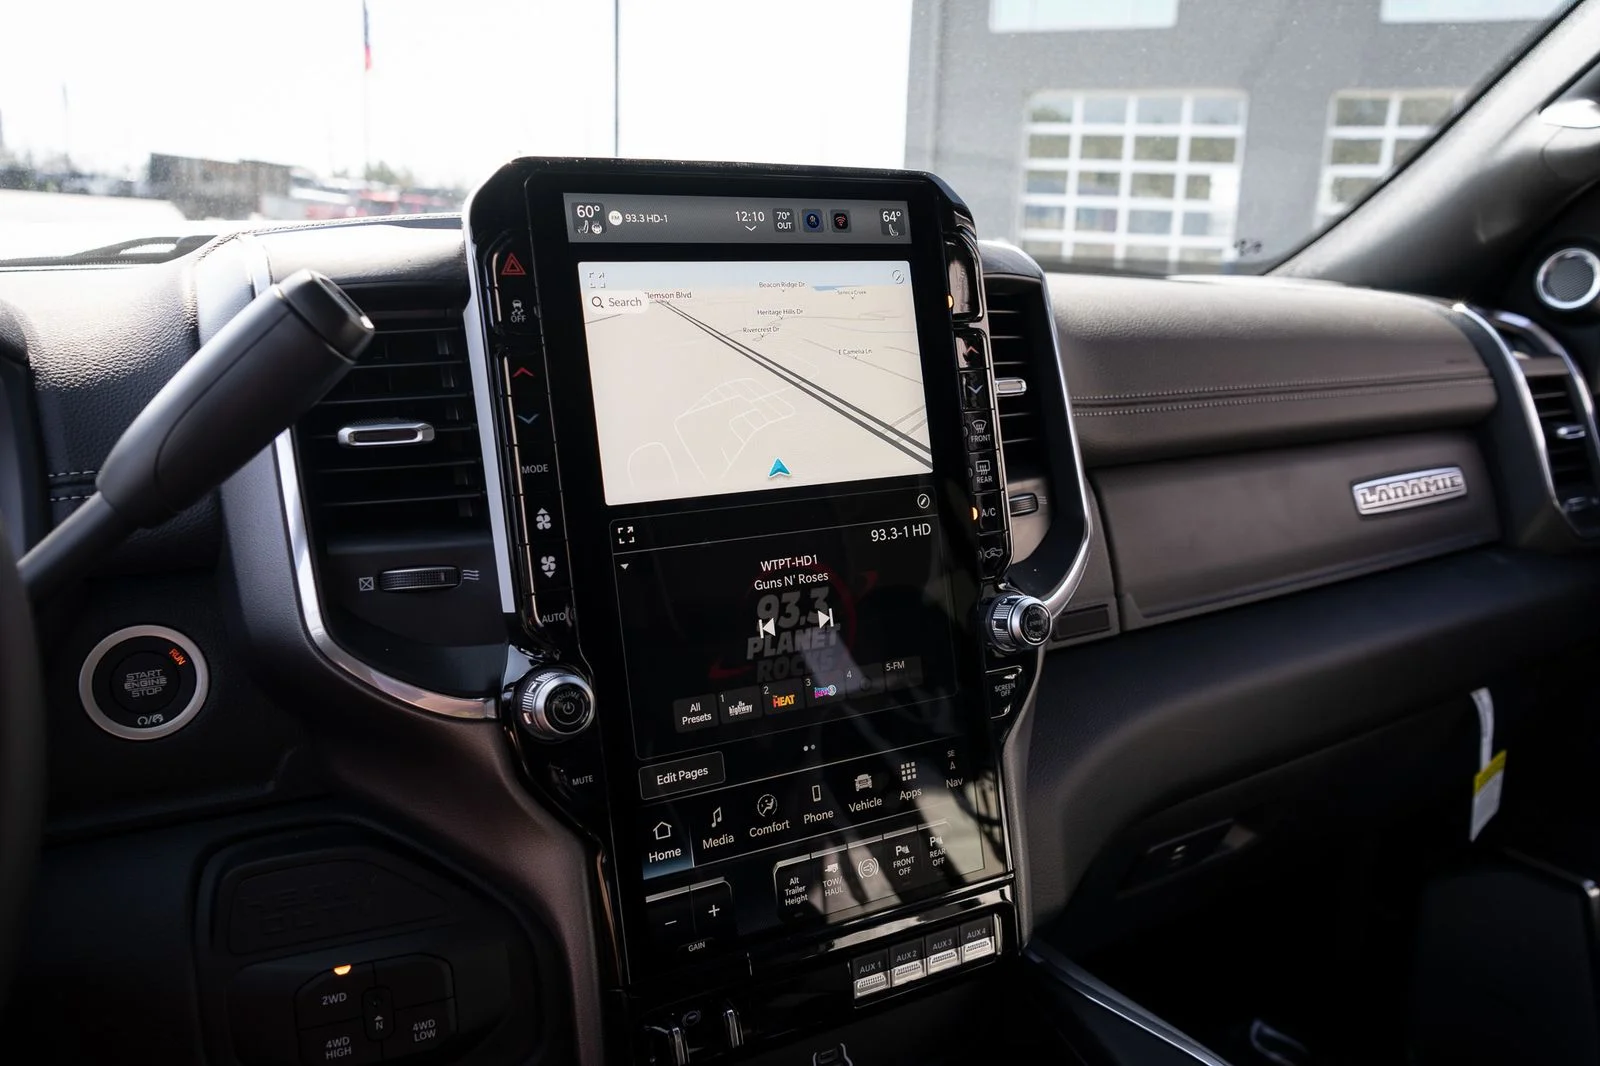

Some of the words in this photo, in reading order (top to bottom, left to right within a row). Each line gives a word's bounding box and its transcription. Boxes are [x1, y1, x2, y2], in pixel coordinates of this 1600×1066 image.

[625, 213, 645, 223] 93.3
[646, 214, 668, 223] HD-1
[735, 211, 765, 222] 12:10
[777, 222, 792, 230] OUT
[759, 281, 780, 289] Beacon
[781, 281, 798, 290] Ridge
[644, 291, 675, 300] lemson
[675, 291, 692, 299] Blvd
[608, 297, 642, 307] Search
[510, 314, 528, 324] OFF
[970, 433, 992, 443] FRONT
[521, 463, 549, 475] MODE
[976, 474, 993, 484] REAR
[981, 507, 997, 518] A/C
[870, 525, 910, 543] 93.3-1
[911, 523, 932, 537] HD
[760, 554, 819, 572] WTPT-HD1
[754, 578, 783, 591] Guns
[784, 575, 796, 587] N'
[798, 571, 829, 585] Roses
[756, 586, 830, 629] 93.3
[542, 611, 566, 624] AUTO
[746, 623, 841, 660] PLANET
[169, 648, 186, 666] RUN
[885, 660, 905, 672] 5-FM
[126, 669, 163, 681] START
[846, 670, 852, 679] 4
[124, 676, 168, 690] ENGINE
[806, 678, 812, 687] 3
[994, 682, 1016, 693] SCREEN
[131, 686, 163, 698] STOP
[764, 685, 769, 695] 2
[1000, 689, 1011, 697] OFF
[720, 694, 725, 703] 1
[773, 694, 796, 709] HEAT
[690, 702, 701, 713] All
[682, 713, 712, 725] Presets
[572, 774, 594, 786] MUTE
[656, 772, 677, 786] Edit
[678, 767, 709, 781] Pages
[946, 777, 963, 788] Nav
[900, 787, 922, 800] Apps
[848, 797, 883, 812] Vehicle
[803, 809, 834, 824] Phone
[749, 820, 791, 838] Comfort
[702, 833, 735, 849] Media
[648, 847, 682, 863] Home
[929, 847, 946, 858] REAR
[892, 856, 915, 868] FRONT
[932, 857, 945, 867] OFF
[898, 867, 912, 876] OFF
[789, 876, 800, 885] Alt
[784, 885, 806, 897] Trailer
[824, 886, 844, 897] HAUL
[784, 893, 809, 907] Height
[966, 930, 981, 940] AUX
[687, 941, 706, 952] GAIN
[932, 941, 947, 951] AUX
[896, 953, 912, 963] AUX
[860, 964, 875, 974] AUX
[322, 992, 347, 1006] 2WD
[375, 1021, 384, 1030] N
[412, 1019, 436, 1032] 4WD
[414, 1029, 436, 1042] LOW
[326, 1036, 350, 1049] 4WD
[325, 1046, 352, 1060] HIGH
